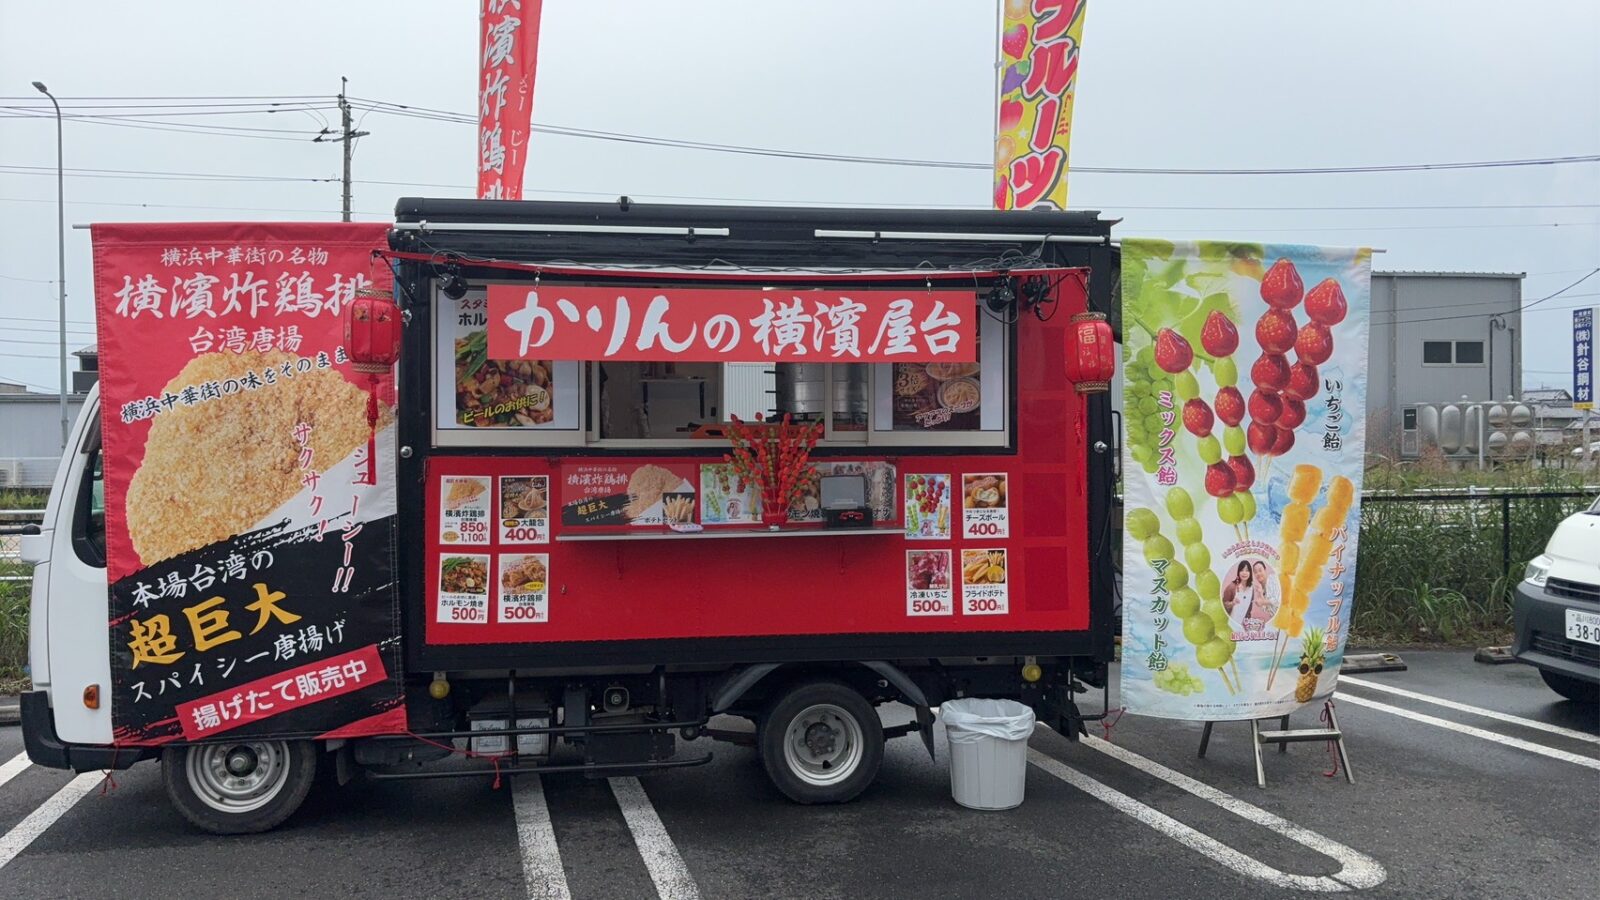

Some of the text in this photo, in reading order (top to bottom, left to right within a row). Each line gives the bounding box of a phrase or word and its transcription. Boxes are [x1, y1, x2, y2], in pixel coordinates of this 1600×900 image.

[1010, 0, 1080, 208] フルーツ
[160, 247, 329, 266] 横浜中華街の名物
[188, 325, 303, 354] 台湾唐揚
[504, 290, 961, 358] かりんの横濱屋台
[121, 346, 349, 424] 横浜中華街の味をそのまま
[1322, 378, 1343, 450] いちご飴
[1157, 391, 1177, 485] ミックス飴
[292, 422, 328, 542] サクサク!
[132, 549, 274, 608] 本場台湾の
[1147, 558, 1170, 672] マスカット飴
[1324, 526, 1348, 652] パイナップル飴
[127, 583, 302, 670] 超巨大
[130, 619, 346, 703] スパイシー唐揚げ
[191, 659, 368, 730] 揚げたて販売中
